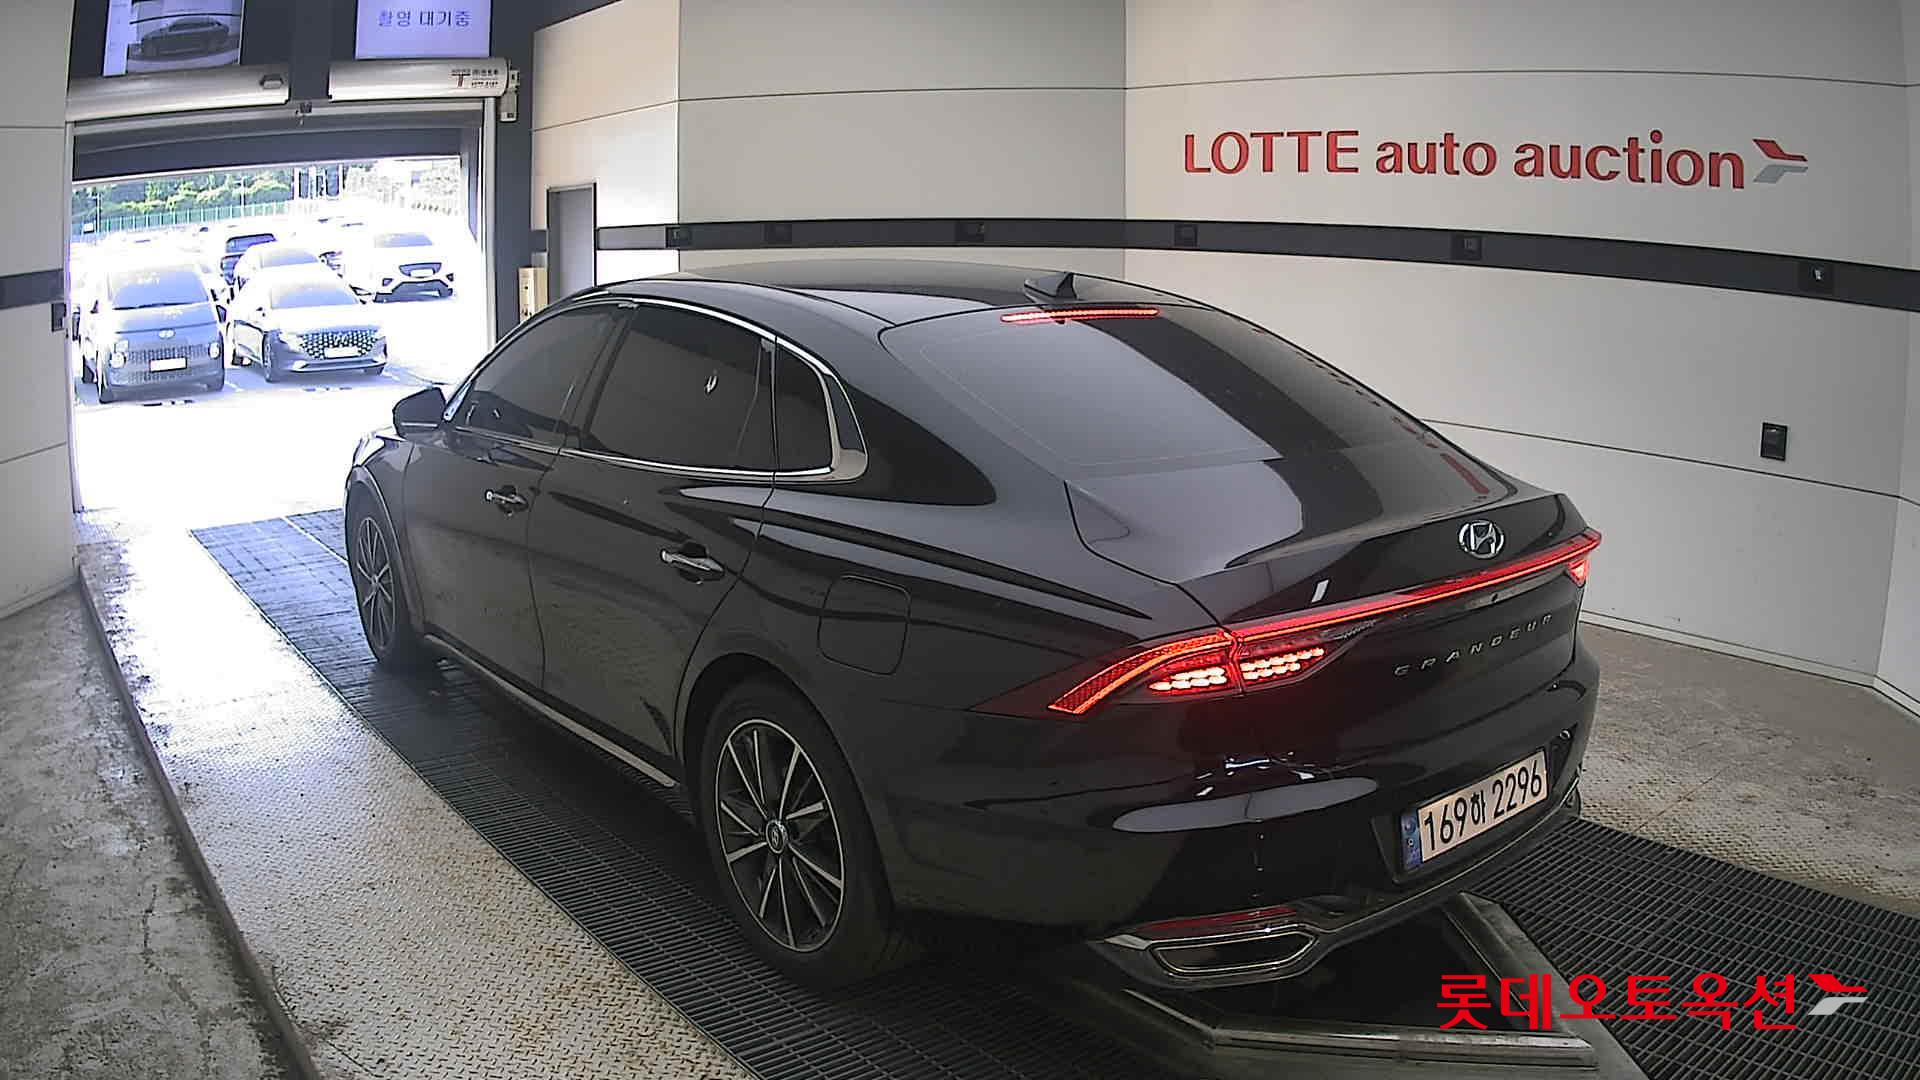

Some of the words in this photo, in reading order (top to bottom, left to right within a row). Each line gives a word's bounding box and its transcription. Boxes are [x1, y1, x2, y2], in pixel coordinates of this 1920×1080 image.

[419, 10, 473, 27] 대기중
[1184, 130, 1360, 174] LOTTE
[1376, 132, 1498, 179] auto
[1513, 129, 1745, 190] auction
[1393, 613, 1553, 676] GRANDEUR
[1492, 760, 1542, 820] 2296
